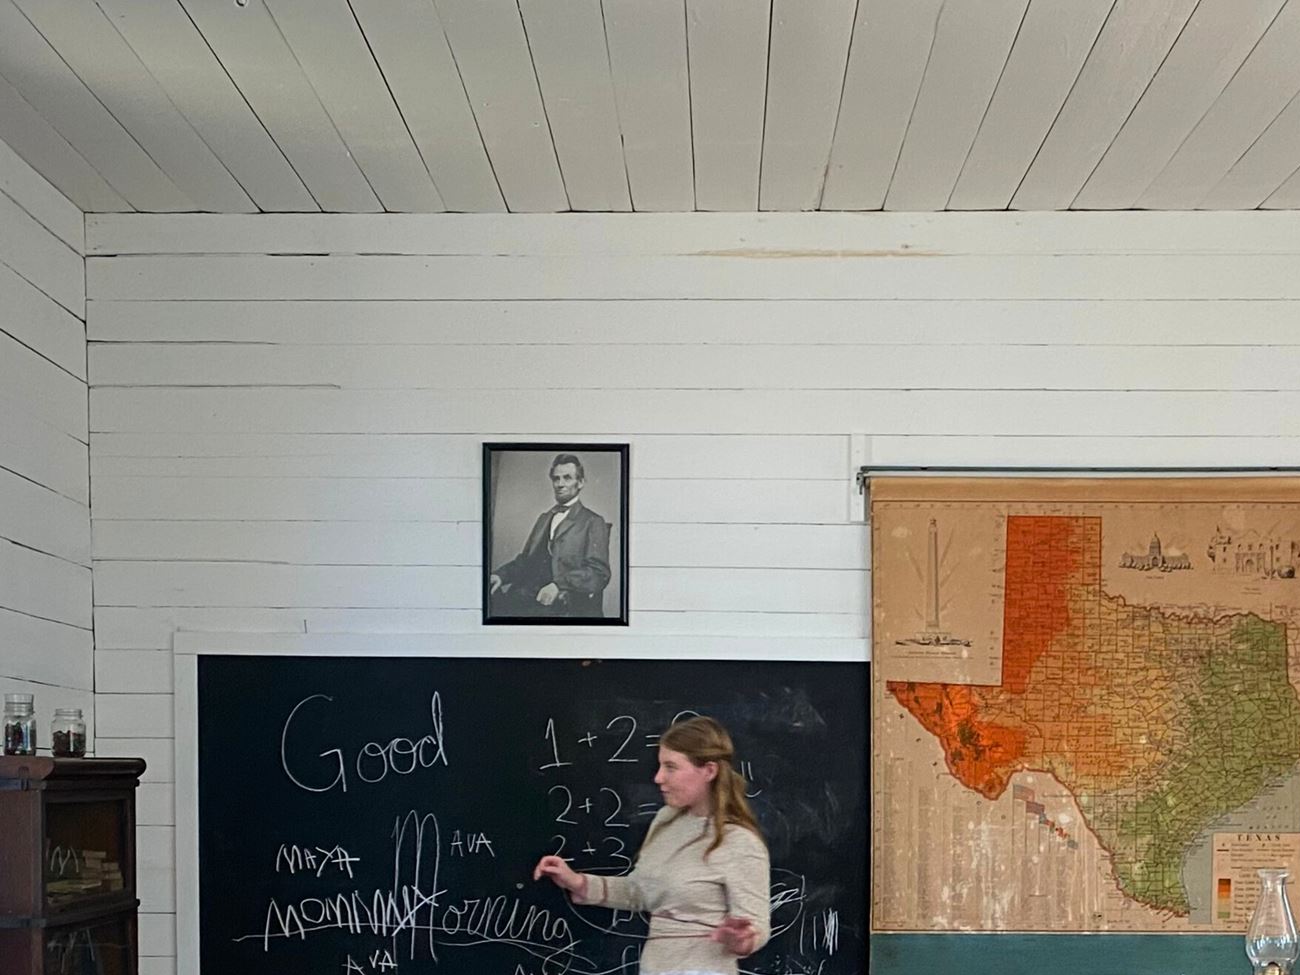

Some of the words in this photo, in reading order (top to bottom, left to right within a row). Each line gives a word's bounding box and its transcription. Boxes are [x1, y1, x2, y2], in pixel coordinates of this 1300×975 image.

[282, 691, 448, 792] Good
[451, 829, 495, 857] AVA
[1237, 833, 1281, 842] TEXAS
[276, 843, 361, 879] MAYA
